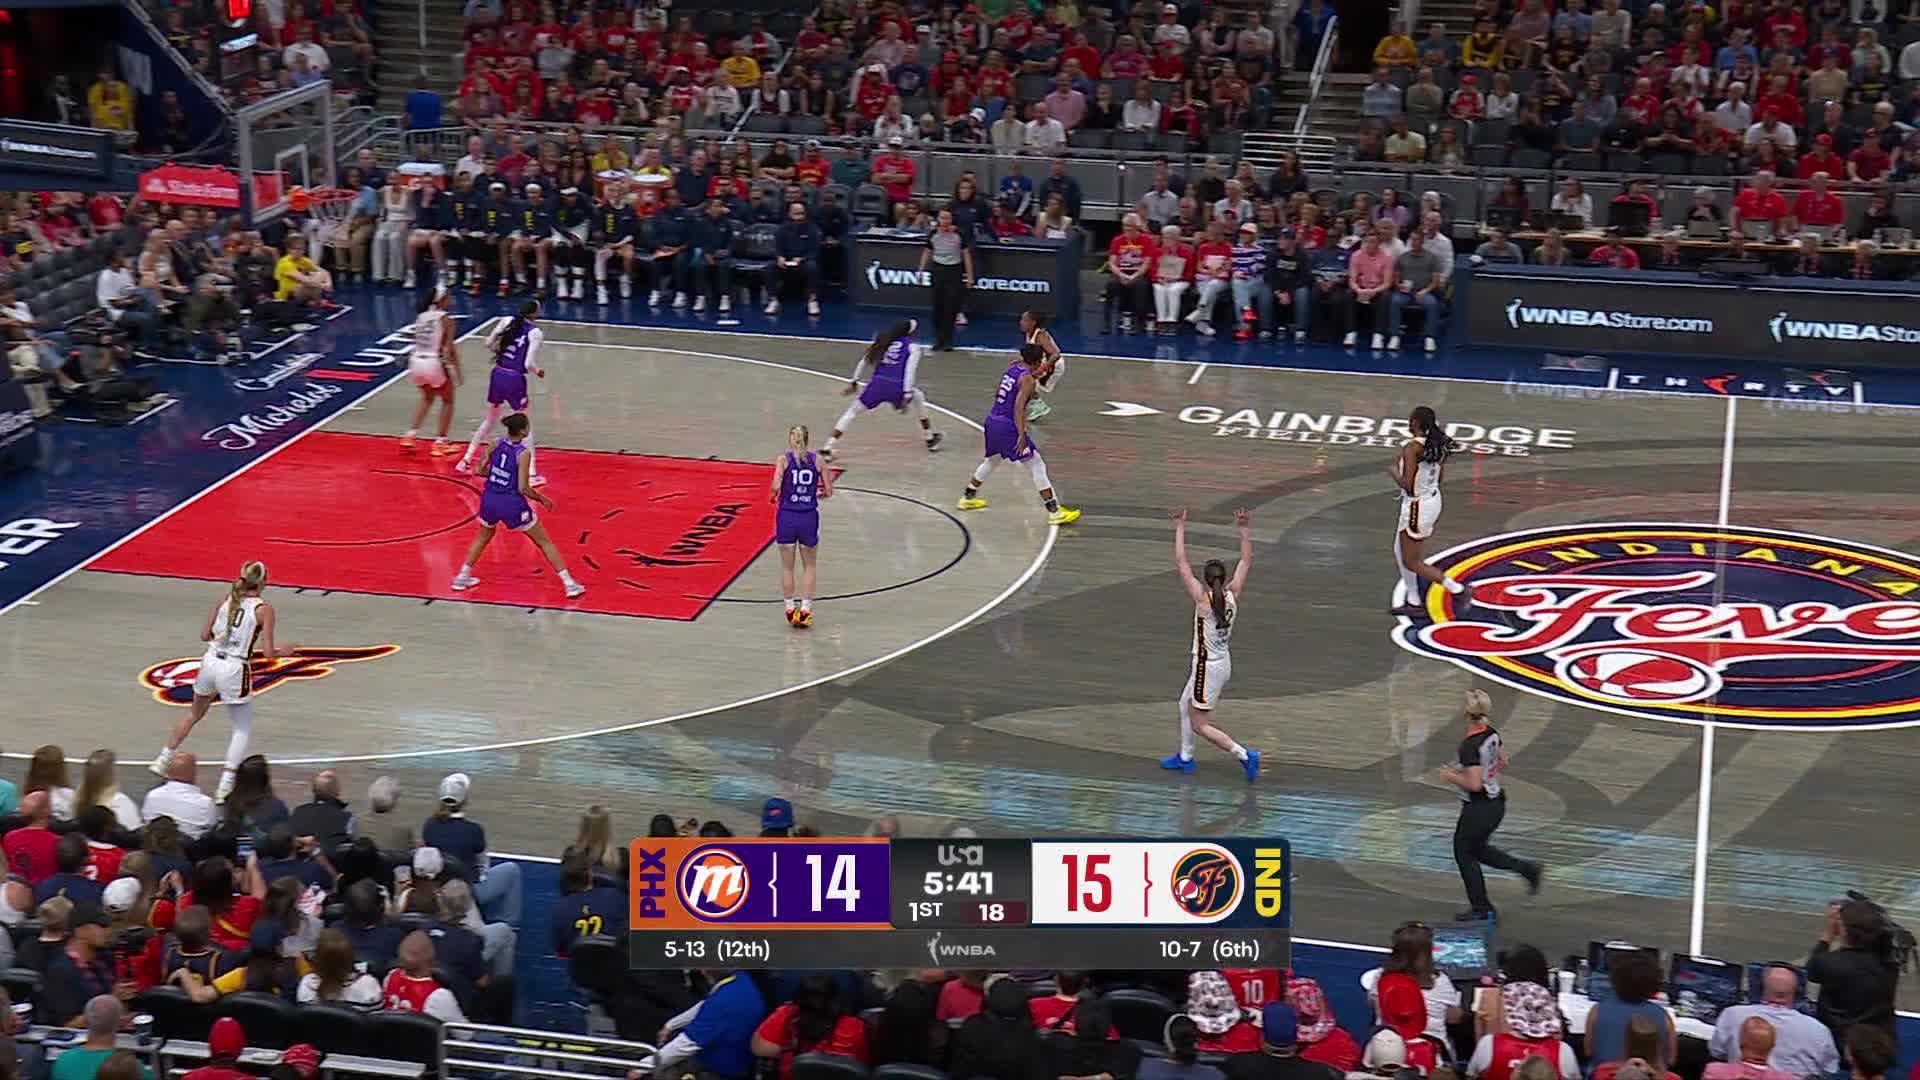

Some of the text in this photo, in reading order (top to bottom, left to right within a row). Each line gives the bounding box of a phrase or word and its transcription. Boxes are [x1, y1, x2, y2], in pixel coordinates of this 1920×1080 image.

[1519, 306, 1713, 332] WNBAStore.com
[1178, 406, 1577, 448] GAINBRDGE
[1212, 426, 1531, 457] FIELDHUSE
[791, 469, 813, 485] 10
[1511, 541, 1920, 597] INDIANA
[1241, 979, 1264, 1004] 10
